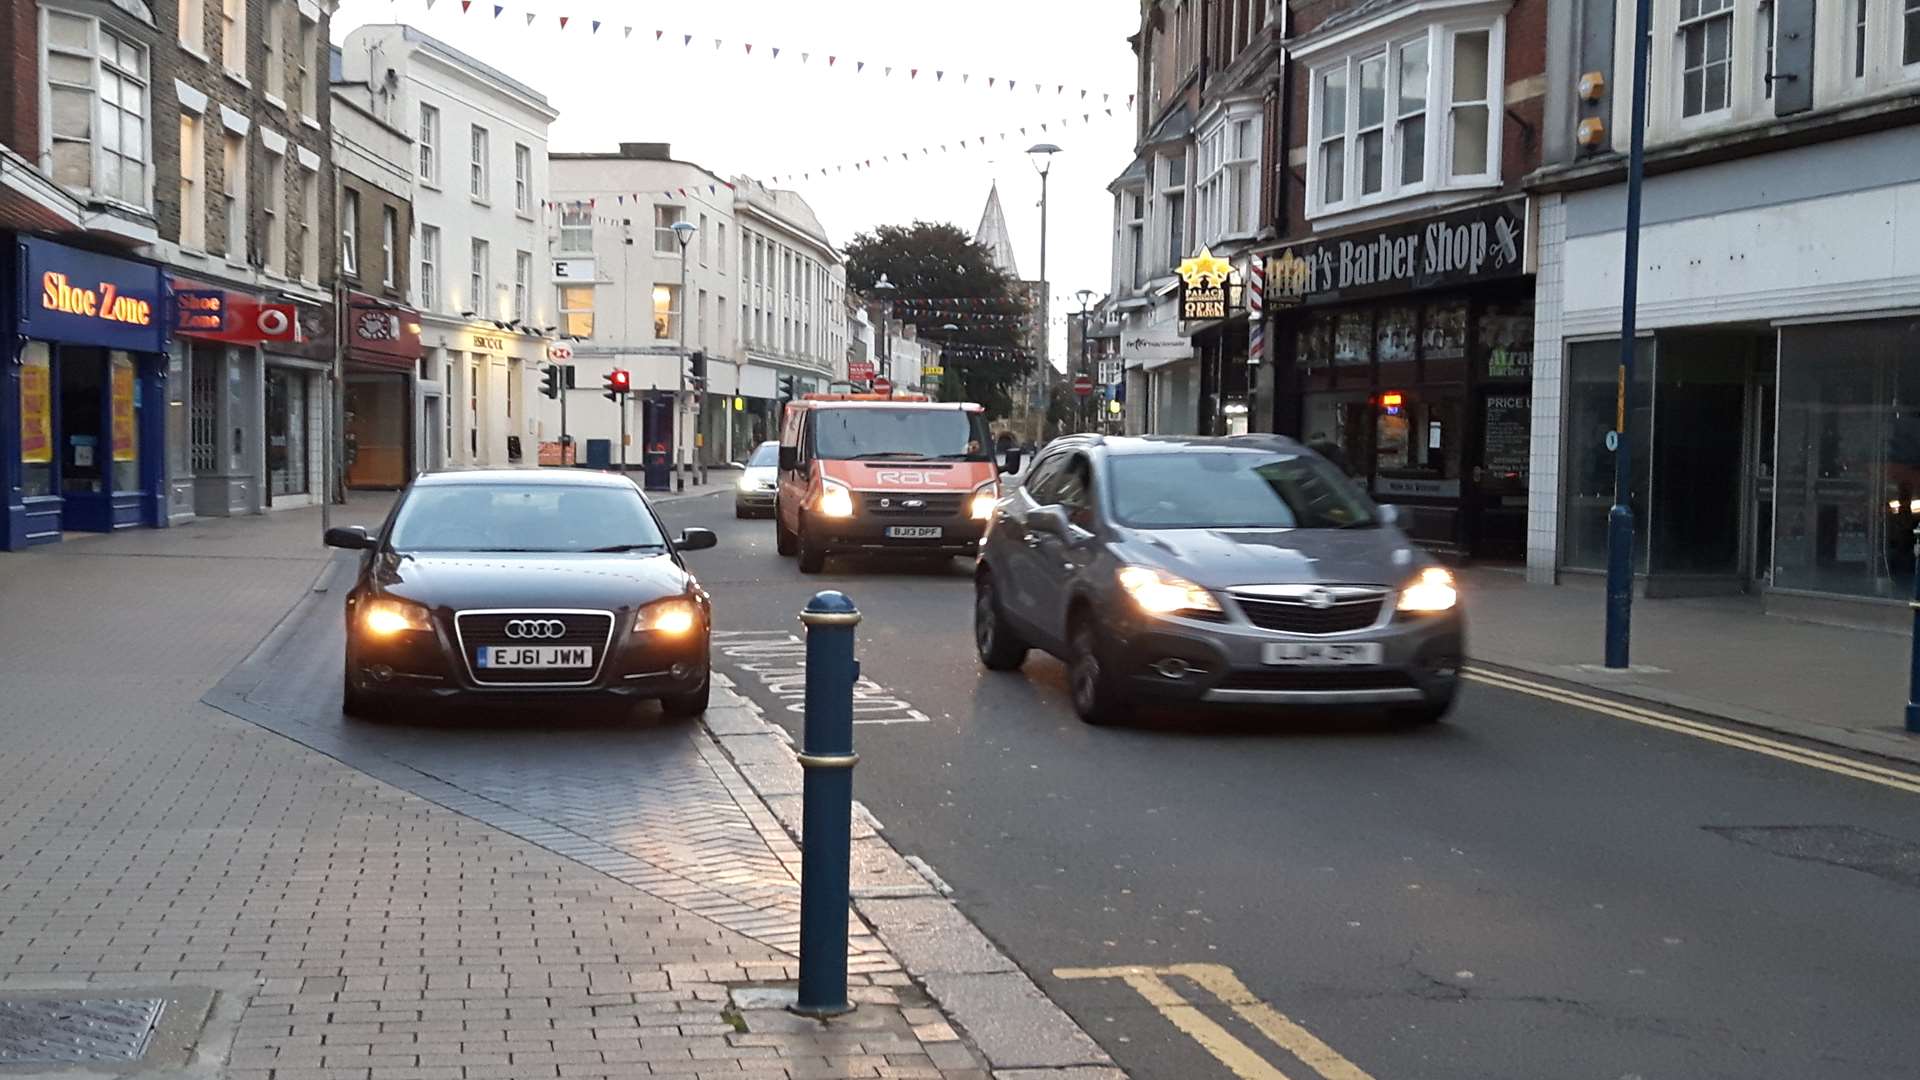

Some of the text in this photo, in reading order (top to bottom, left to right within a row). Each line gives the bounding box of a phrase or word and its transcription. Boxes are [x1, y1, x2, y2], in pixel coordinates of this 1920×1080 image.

[1264, 219, 1487, 299] Arran's Barber Shop
[43, 271, 150, 326] Shoe Zone
[1185, 289, 1224, 298] PALACE
[178, 292, 221, 312] Shoe
[1185, 302, 1224, 311] OPEN
[178, 313, 221, 328] Zone
[1487, 398, 1522, 409] PRICE
[894, 527, 937, 537] BJ13 DPF
[495, 649, 585, 665] EJ61 JWM
